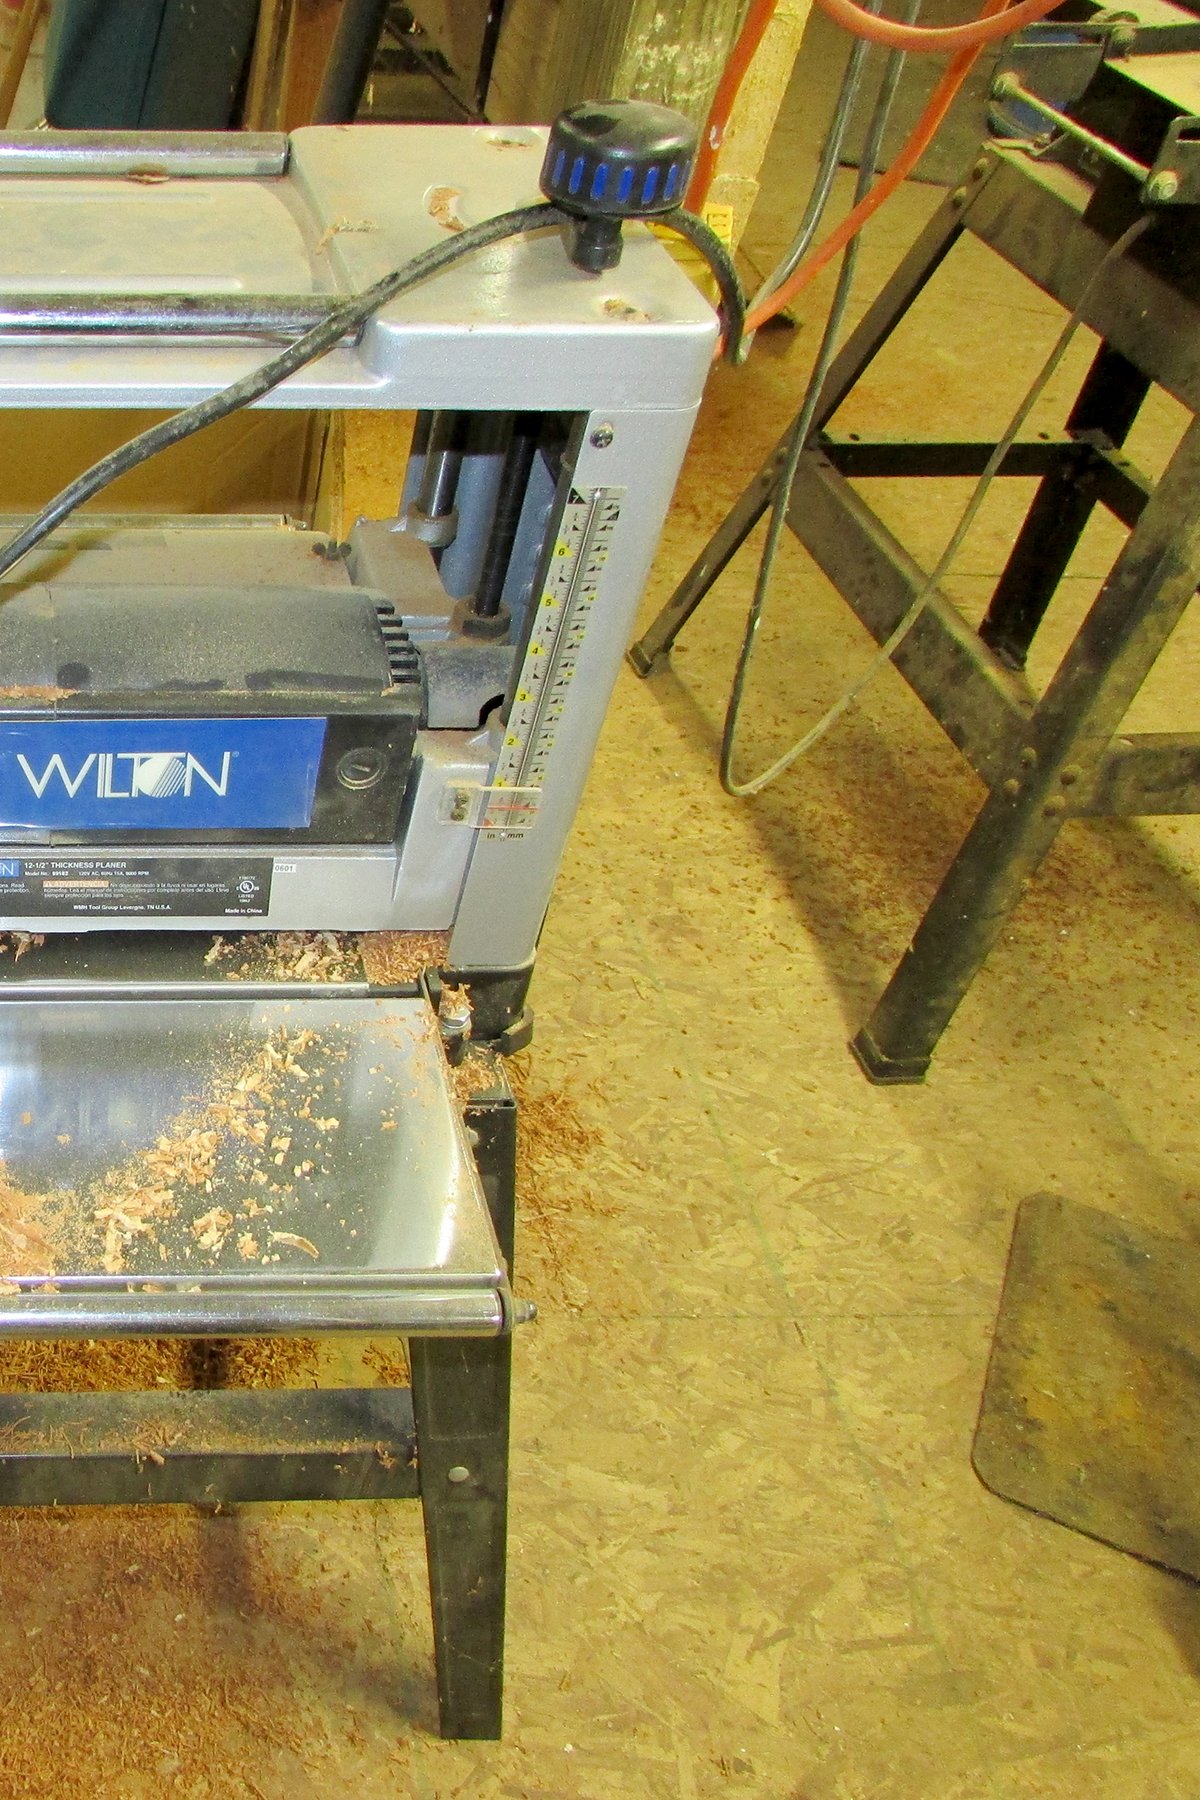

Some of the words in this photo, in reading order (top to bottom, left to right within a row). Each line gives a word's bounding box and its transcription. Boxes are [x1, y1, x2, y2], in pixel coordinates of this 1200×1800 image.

[572, 495, 579, 504] 7
[558, 548, 565, 556] 6
[545, 599, 552, 607] 5
[519, 693, 527, 701] 3
[16, 751, 230, 799] WILTON
